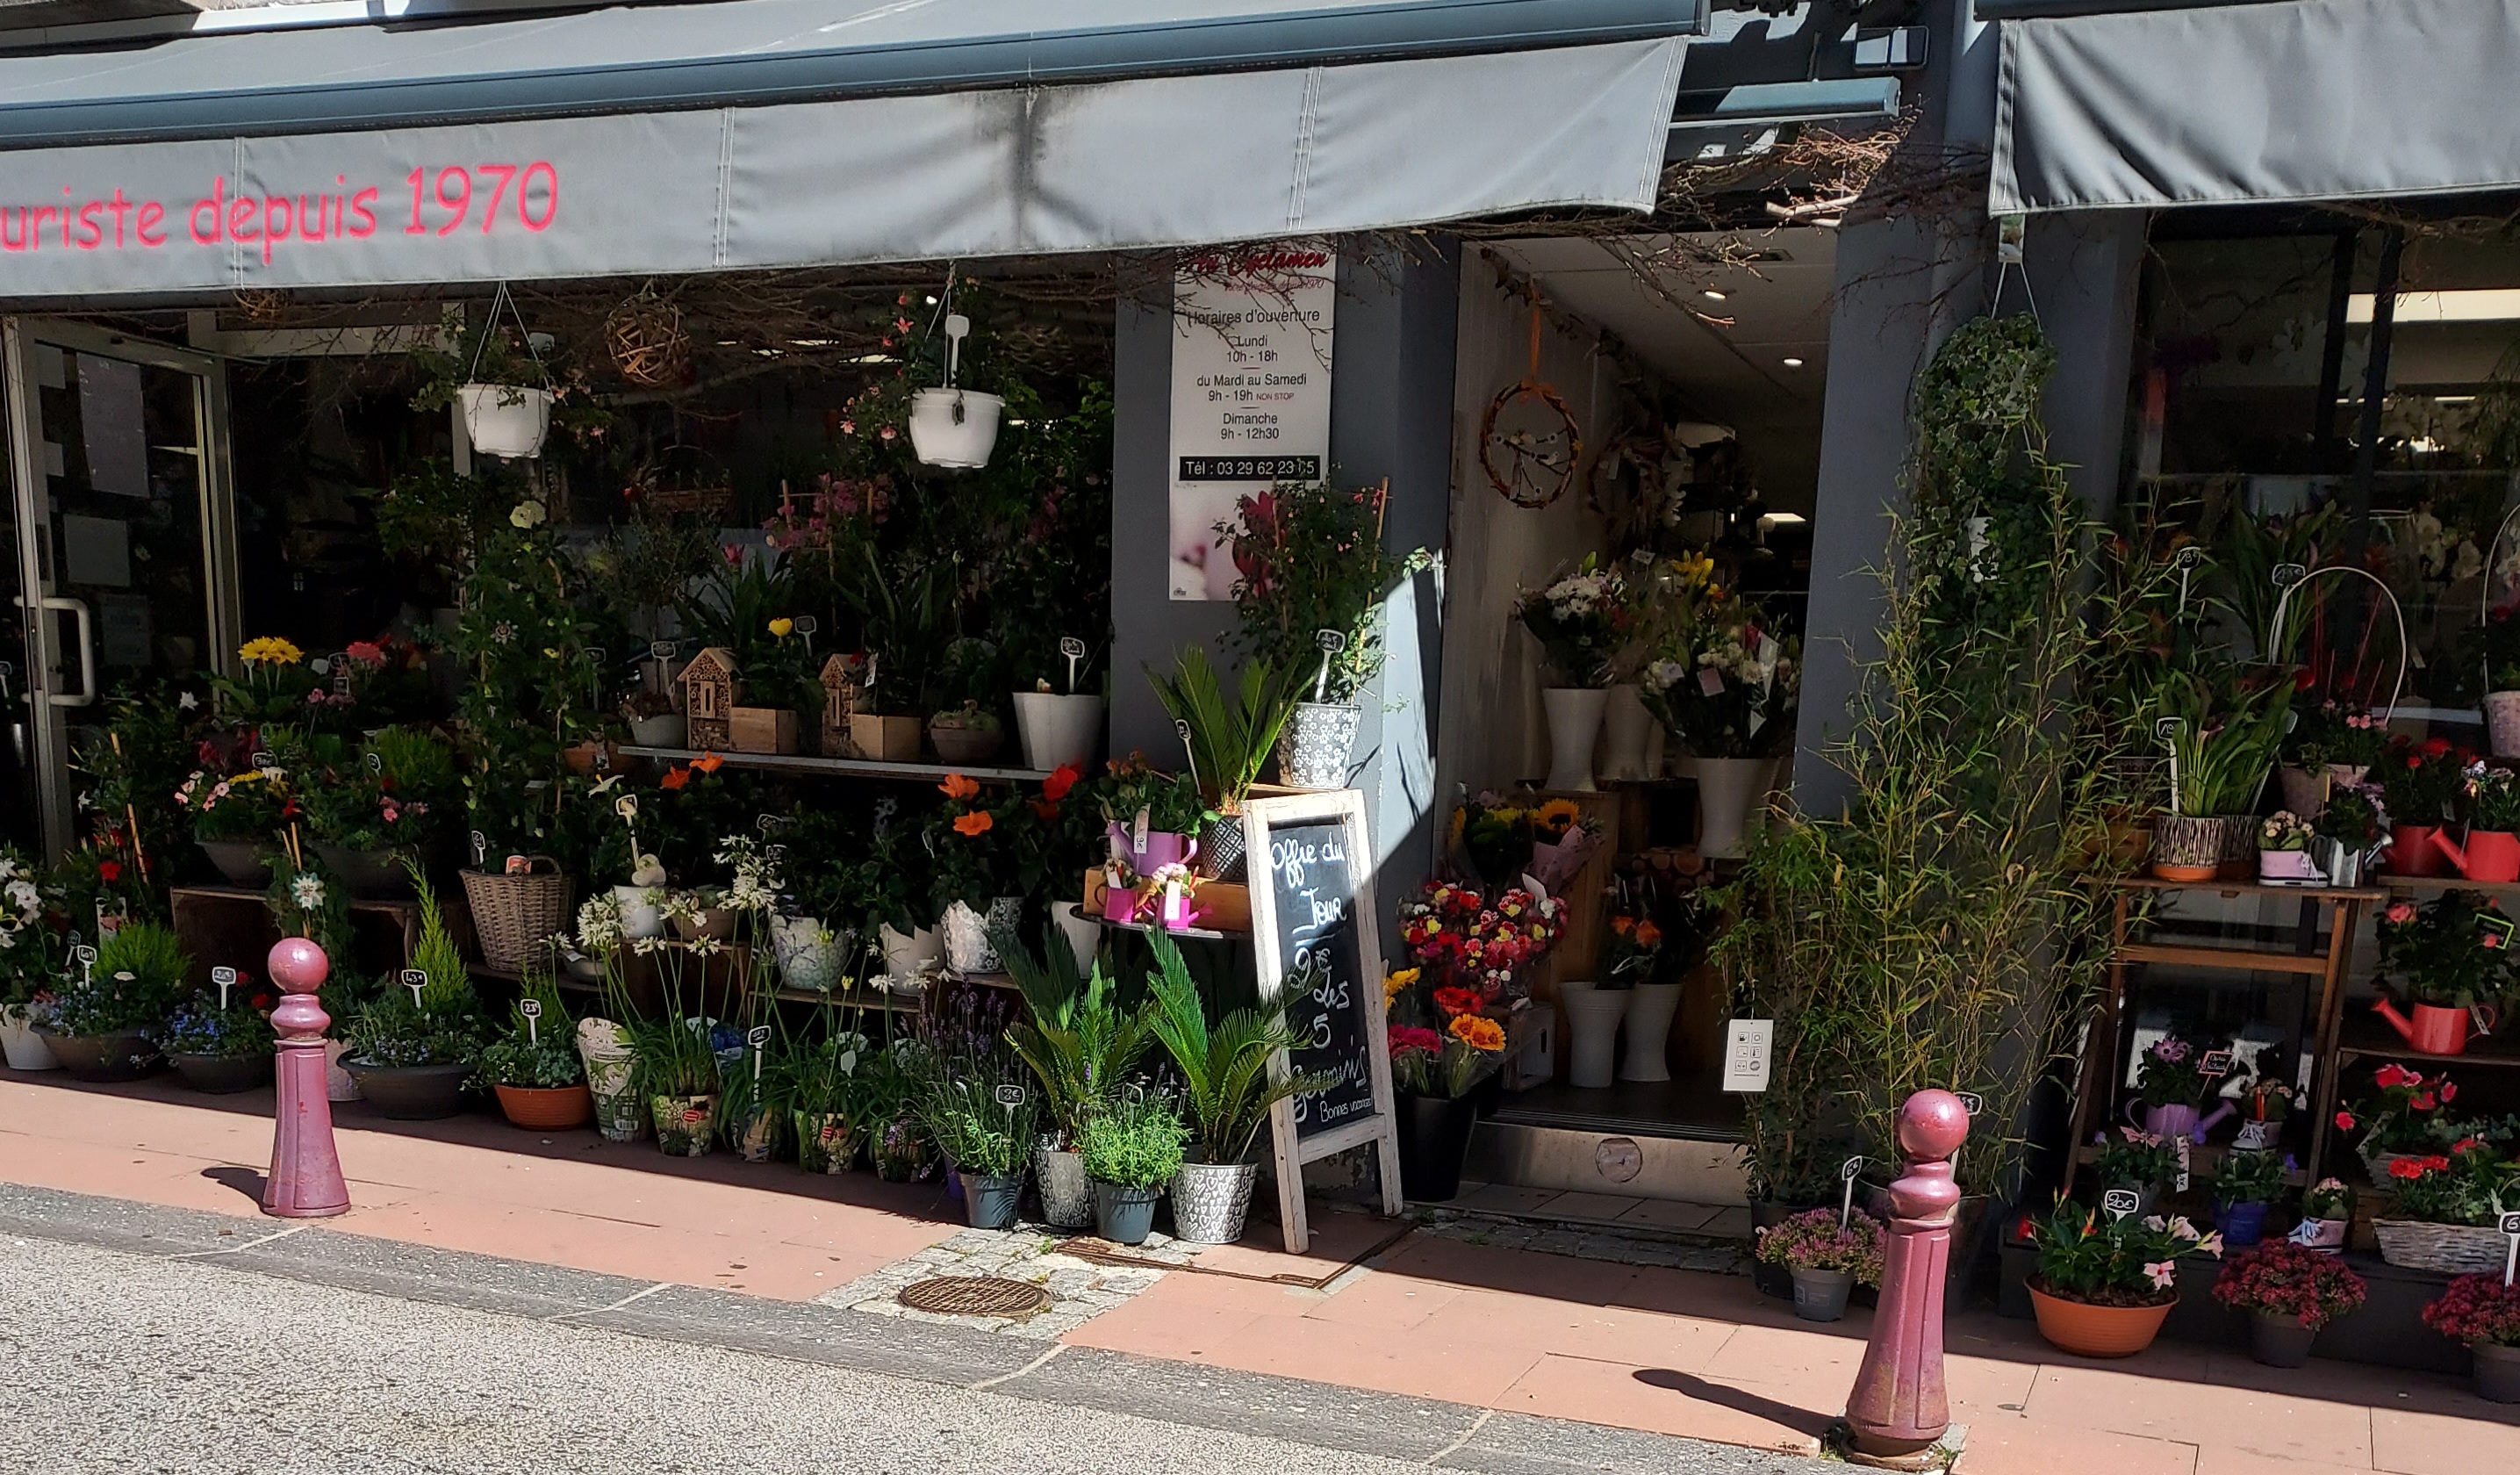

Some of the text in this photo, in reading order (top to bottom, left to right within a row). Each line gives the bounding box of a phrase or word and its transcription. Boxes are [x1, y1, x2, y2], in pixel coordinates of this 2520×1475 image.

[1, 160, 559, 267] uriste depuis 1970
[1188, 309, 1320, 325] Horaires d'ouverture
[1237, 335, 1268, 347] Lundi
[1227, 350, 1247, 363] 10h
[1258, 350, 1278, 363] 18h
[1196, 372, 1307, 386] du Mardi au Samedi
[1208, 390, 1222, 401] 9h
[1233, 390, 1253, 401] 19h
[1223, 413, 1278, 424] Dimanche
[1220, 428, 1234, 439] 9h
[1246, 428, 1280, 439] 12h30
[1217, 462, 1233, 475] 03
[1237, 461, 1253, 475] 29
[1257, 461, 1274, 474] 62
[1277, 460, 1294, 474] 23
[1270, 831, 1346, 889] Offre du
[1312, 1012, 1332, 1050] 5
[1319, 1100, 1349, 1123] Bonnes
